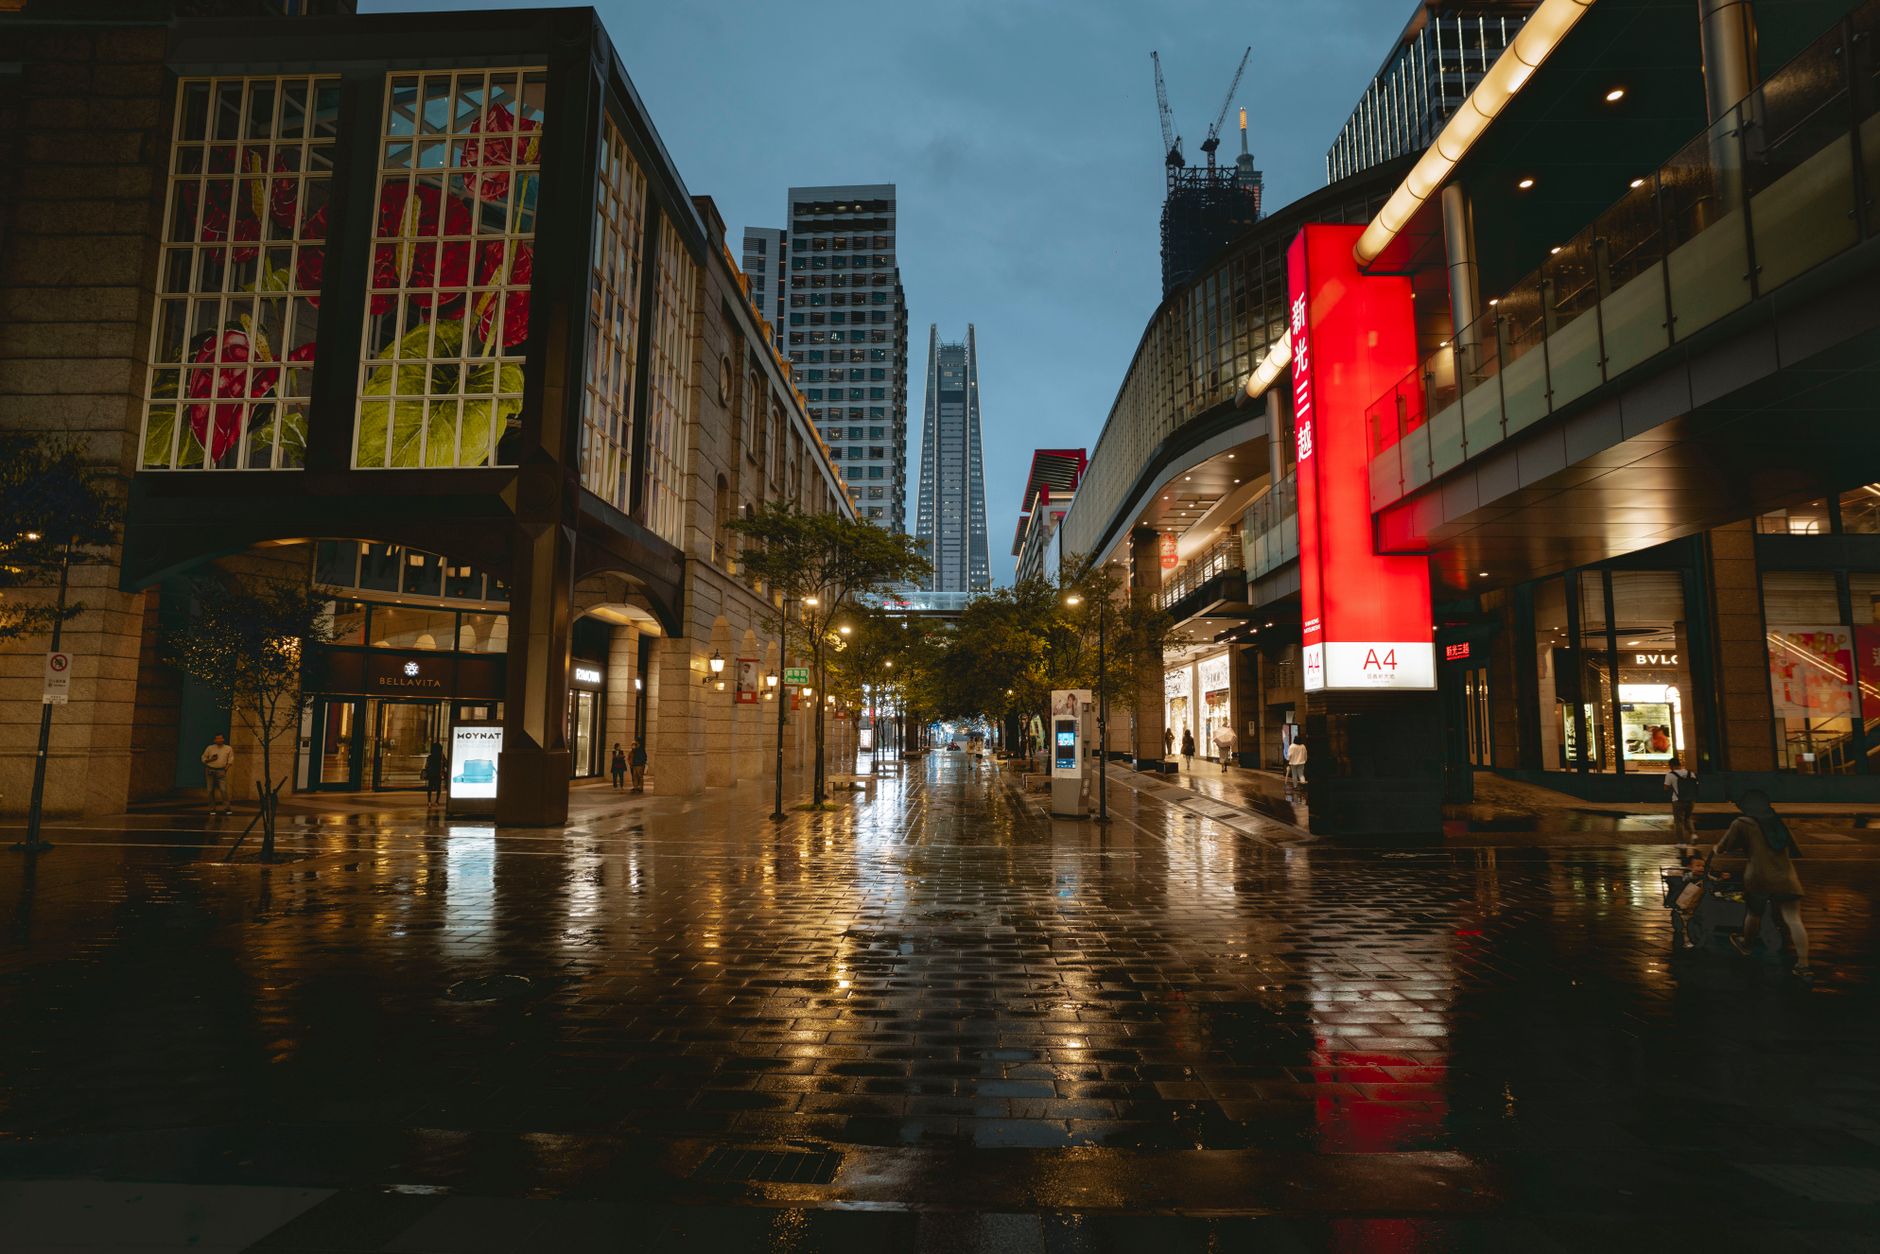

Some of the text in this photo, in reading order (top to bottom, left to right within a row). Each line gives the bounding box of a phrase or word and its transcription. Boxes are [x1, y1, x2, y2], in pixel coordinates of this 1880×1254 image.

[1292, 291, 1312, 462] 新光三越
[1307, 651, 1320, 675] A4
[1363, 648, 1398, 670] A4
[379, 677, 441, 688] BELLAVITA
[456, 732, 502, 740] MOYNAT
